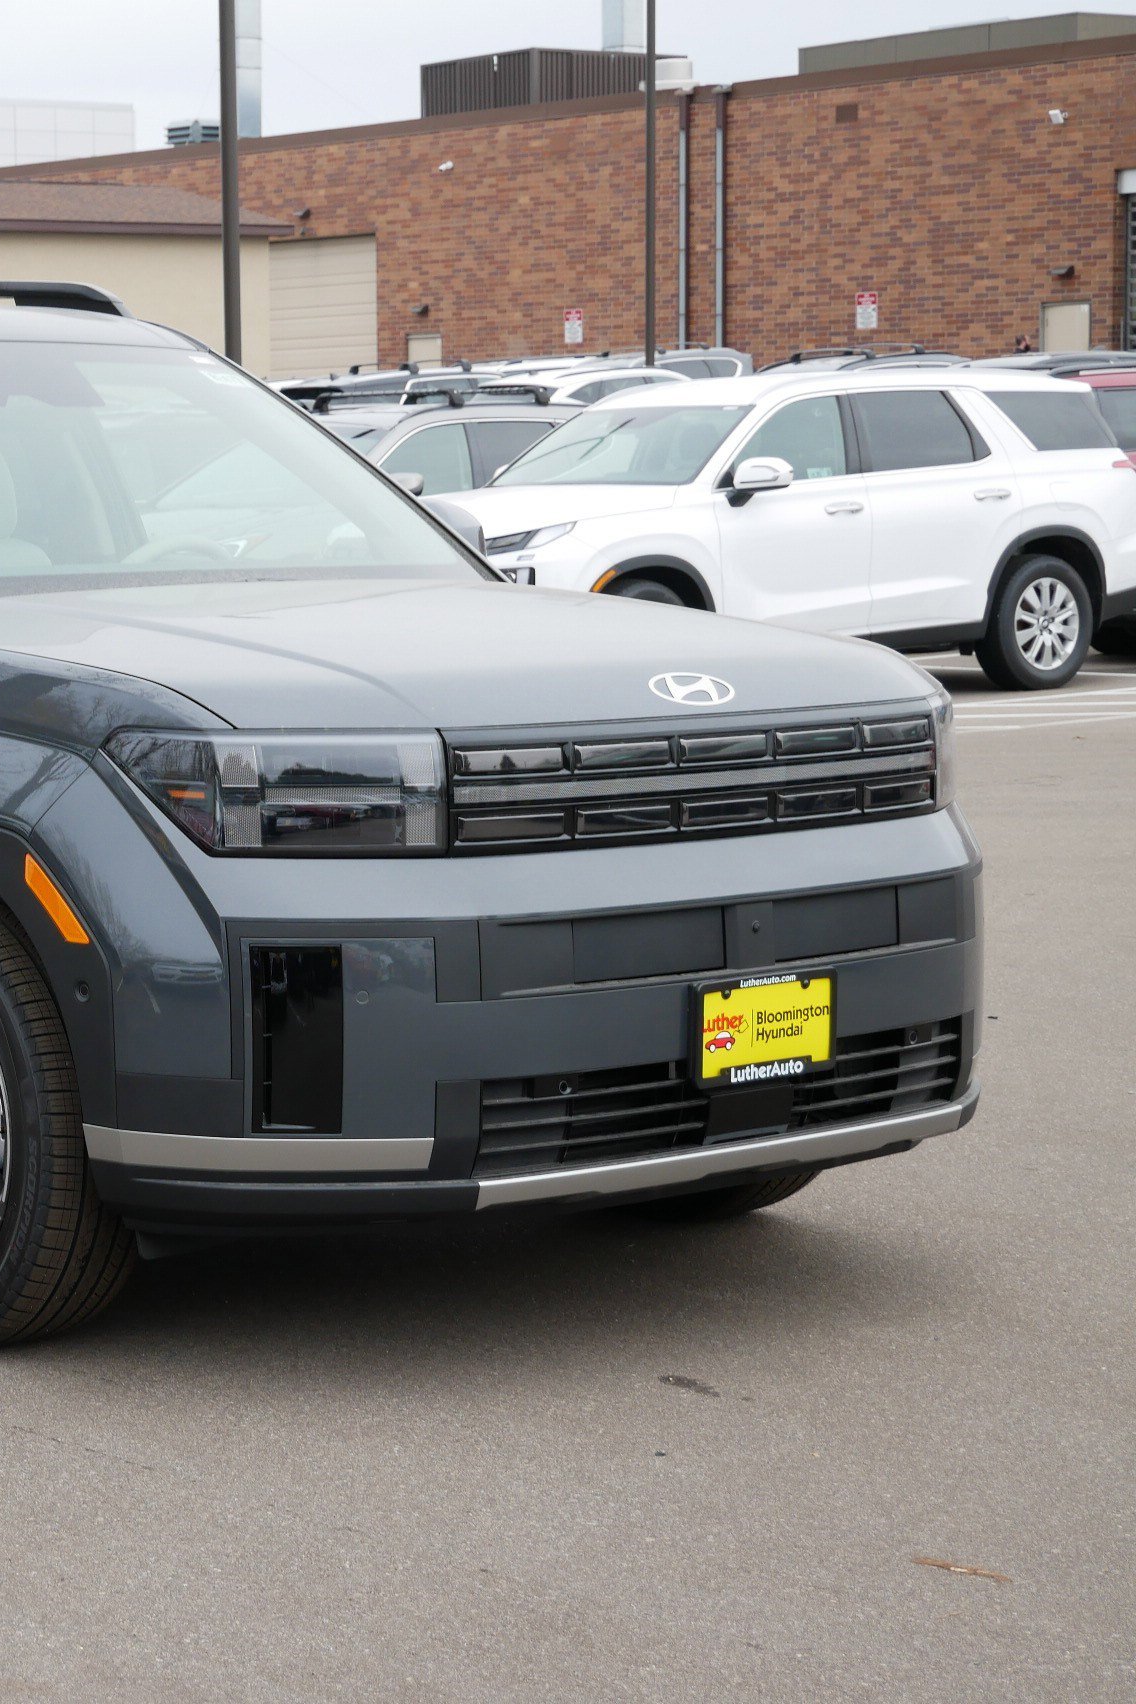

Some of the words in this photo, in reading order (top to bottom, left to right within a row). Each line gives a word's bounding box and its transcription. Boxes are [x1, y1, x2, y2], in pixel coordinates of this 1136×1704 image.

[740, 974, 796, 988] LutherAuto.com
[756, 1005, 829, 1025] Bloomington
[756, 1021, 803, 1043] Hyundai
[730, 1060, 804, 1083] LutherAuto
